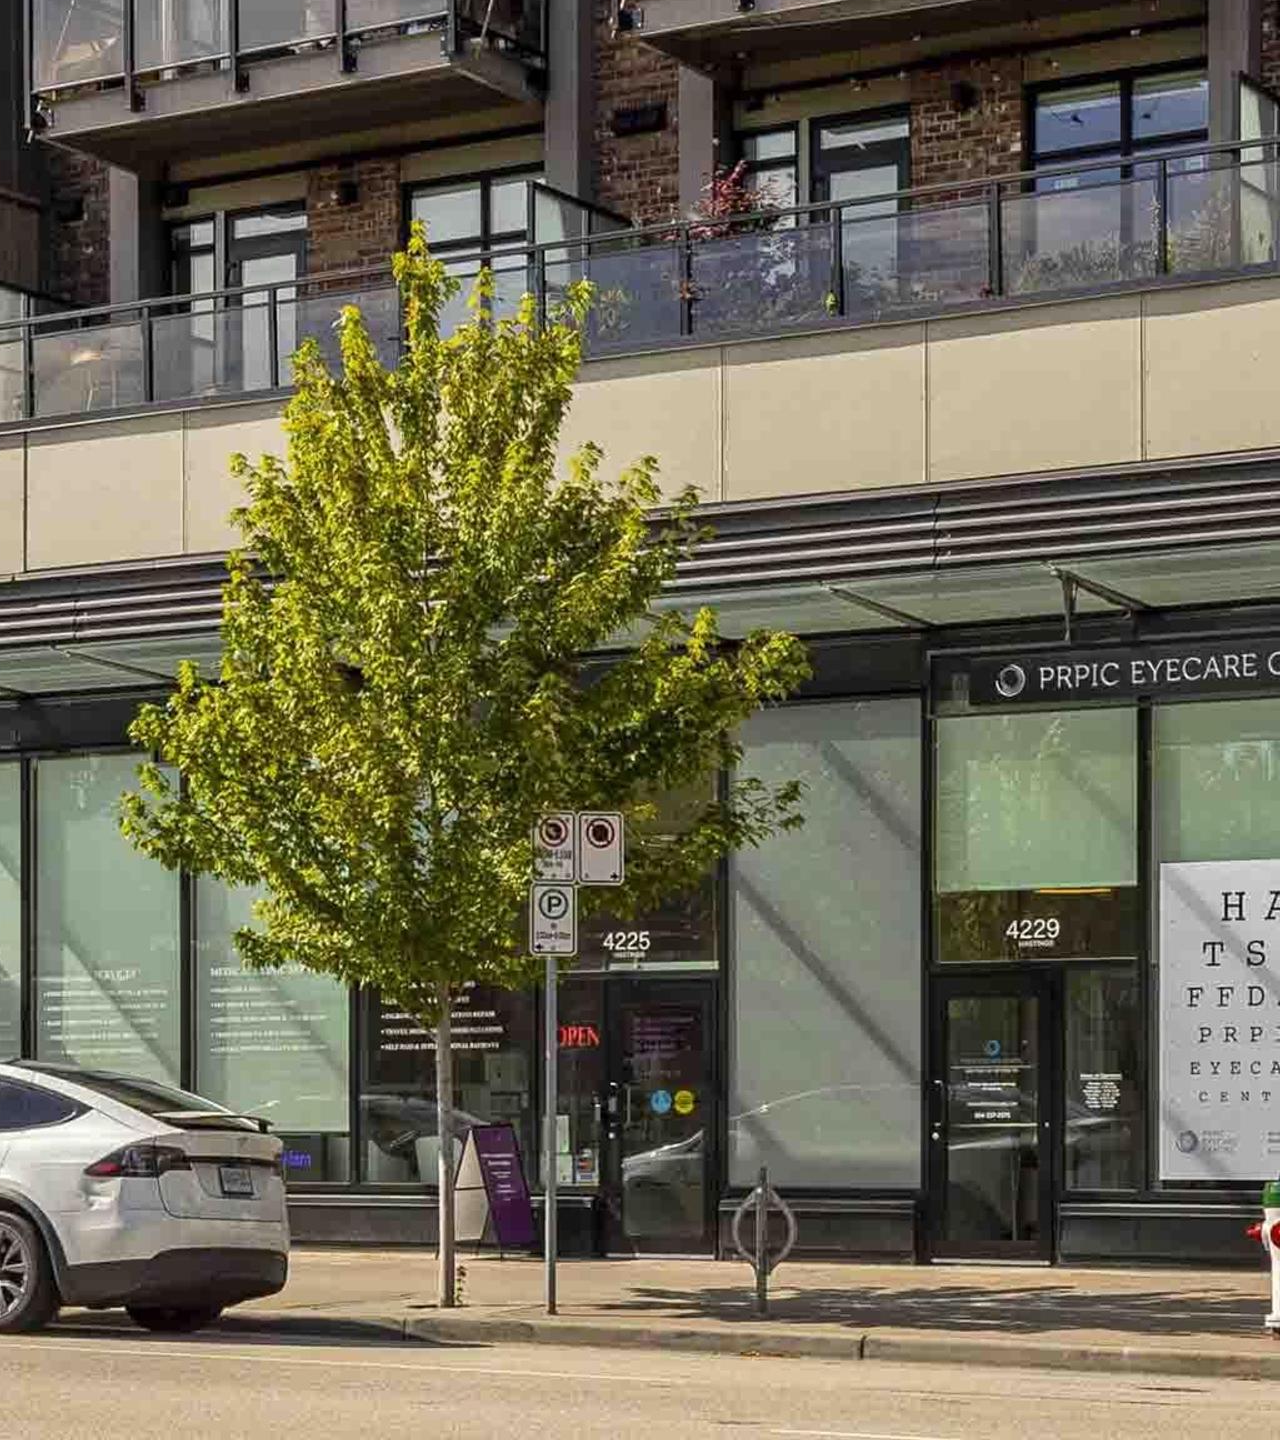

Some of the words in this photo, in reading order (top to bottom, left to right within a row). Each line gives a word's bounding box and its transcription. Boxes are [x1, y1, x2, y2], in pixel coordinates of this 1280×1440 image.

[1039, 662, 1120, 689] PRPIC
[1131, 653, 1258, 684] EYECARE
[1006, 918, 1060, 939] 4229
[603, 931, 651, 950] 4225
